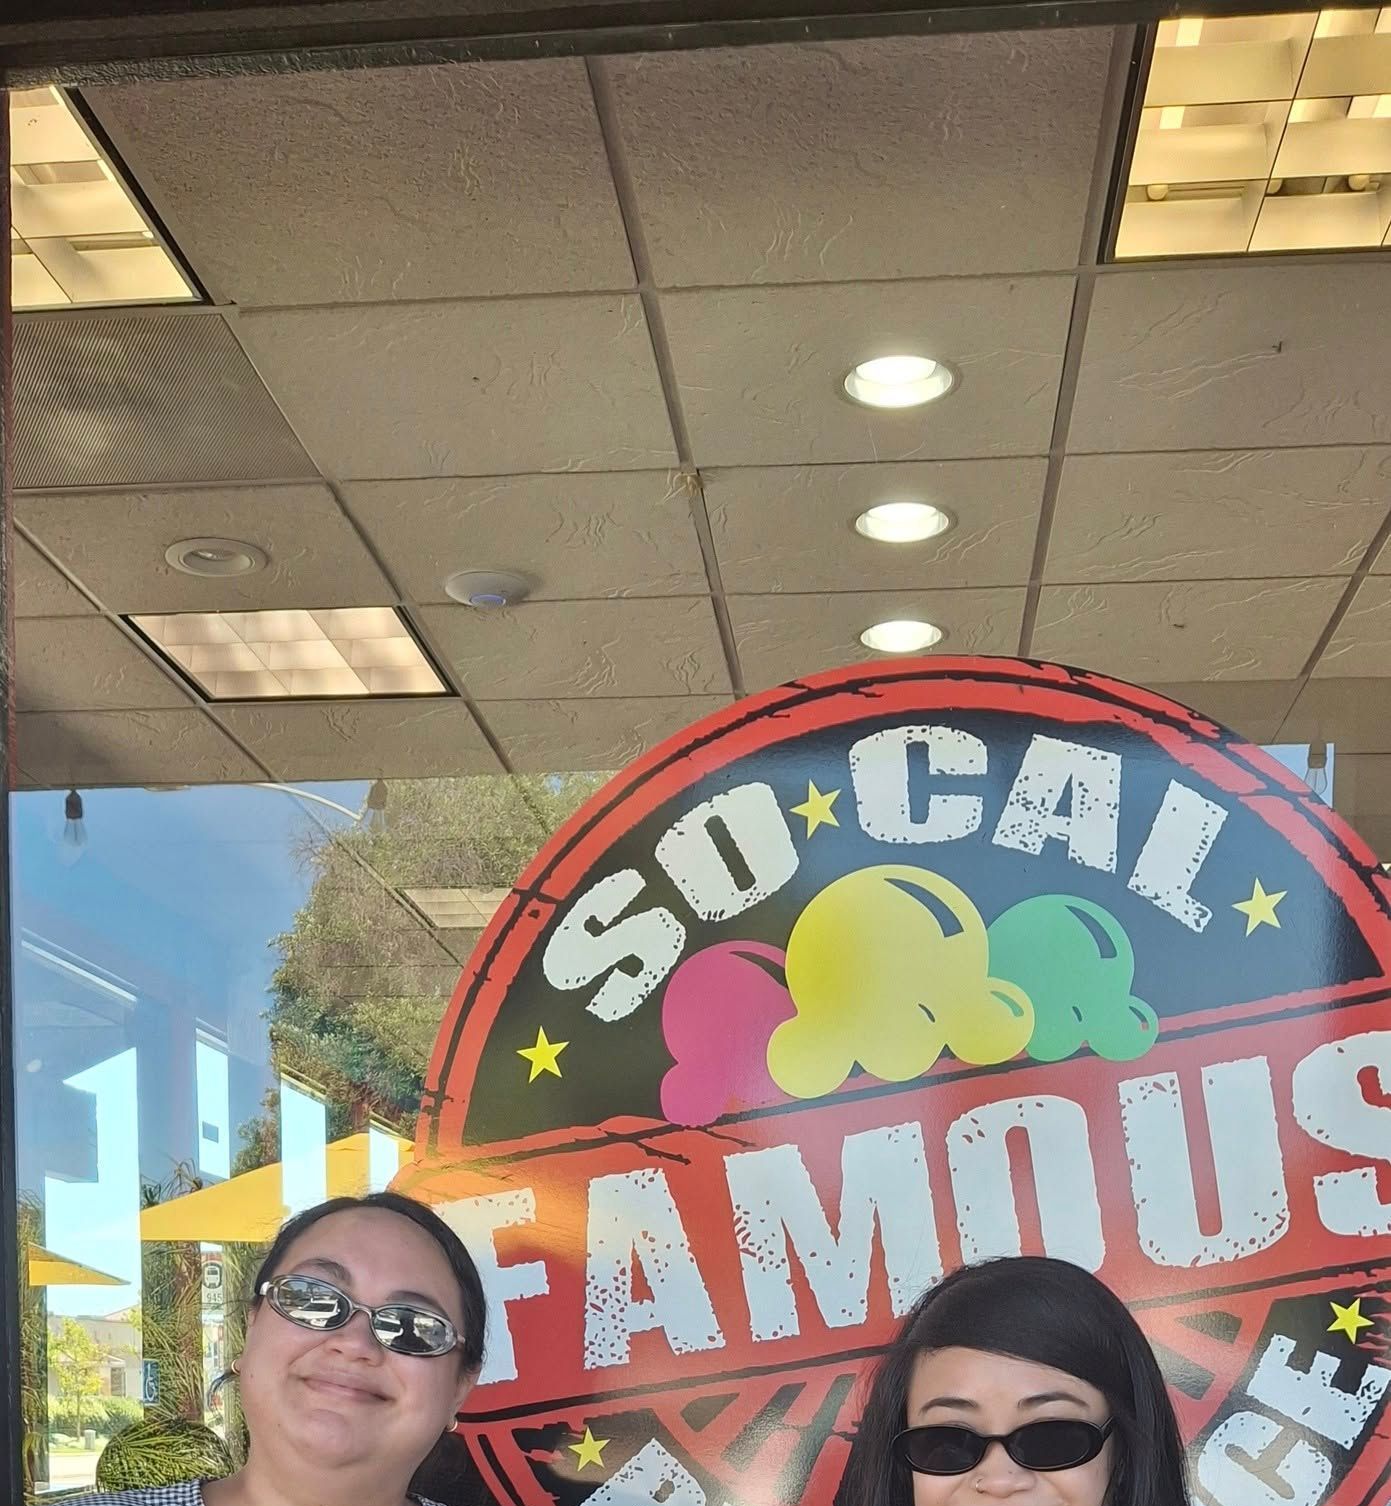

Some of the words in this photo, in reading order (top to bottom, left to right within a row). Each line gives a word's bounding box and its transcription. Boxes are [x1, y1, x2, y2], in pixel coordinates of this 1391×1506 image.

[541, 781, 800, 1023] SO
[847, 723, 1228, 933] CAL
[432, 1030, 1391, 1385] FAMOUS
